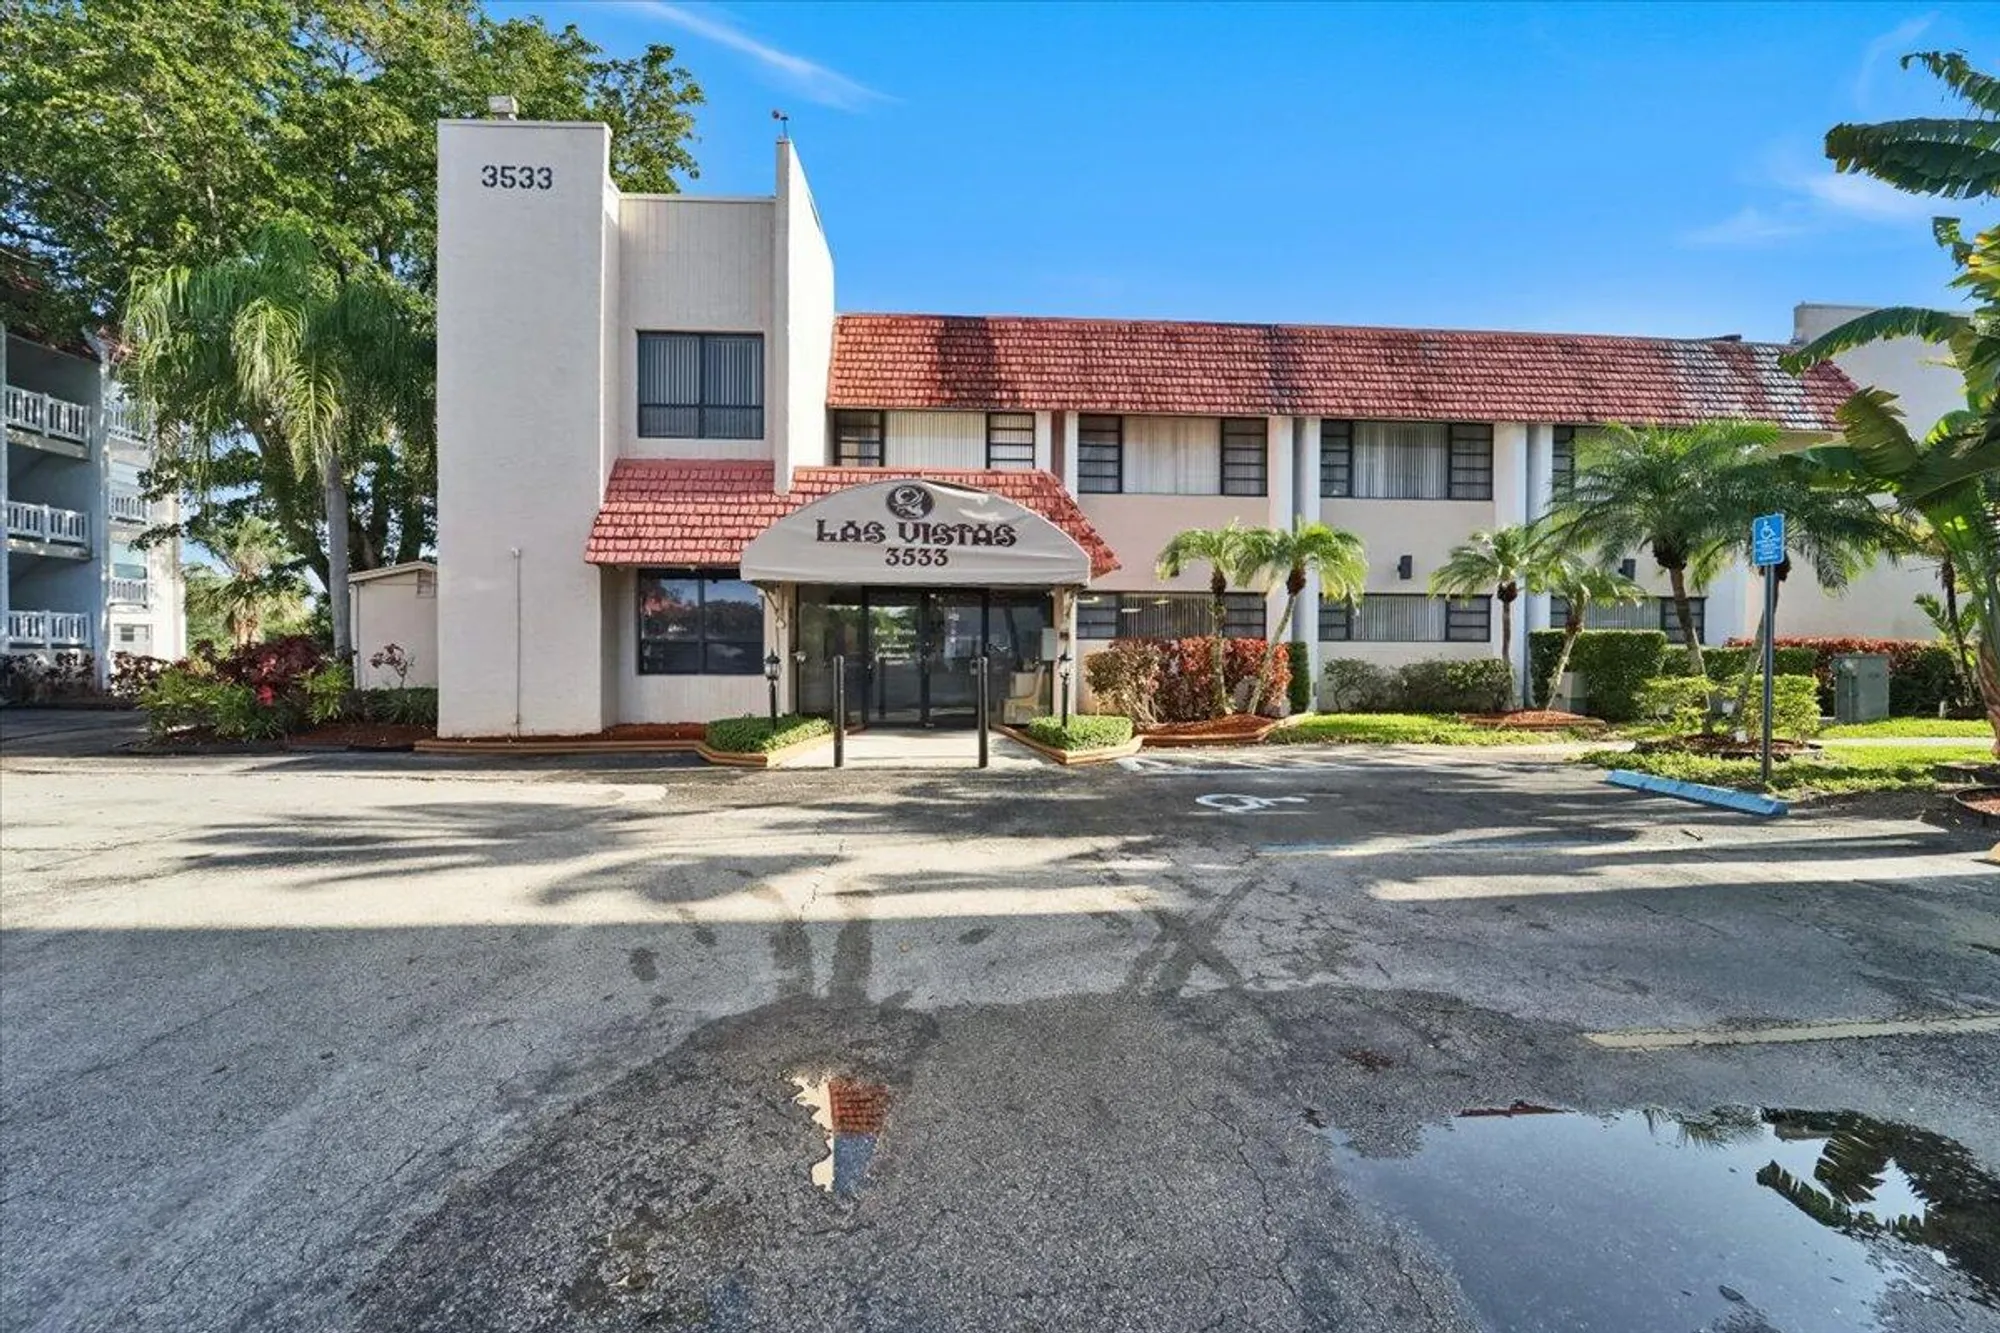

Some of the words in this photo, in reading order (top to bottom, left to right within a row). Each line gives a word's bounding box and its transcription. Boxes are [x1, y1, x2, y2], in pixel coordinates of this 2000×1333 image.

[481, 164, 553, 190] 3533
[816, 519, 886, 544] LAS
[898, 521, 1017, 547] VISTAS
[885, 547, 949, 567] 3533
